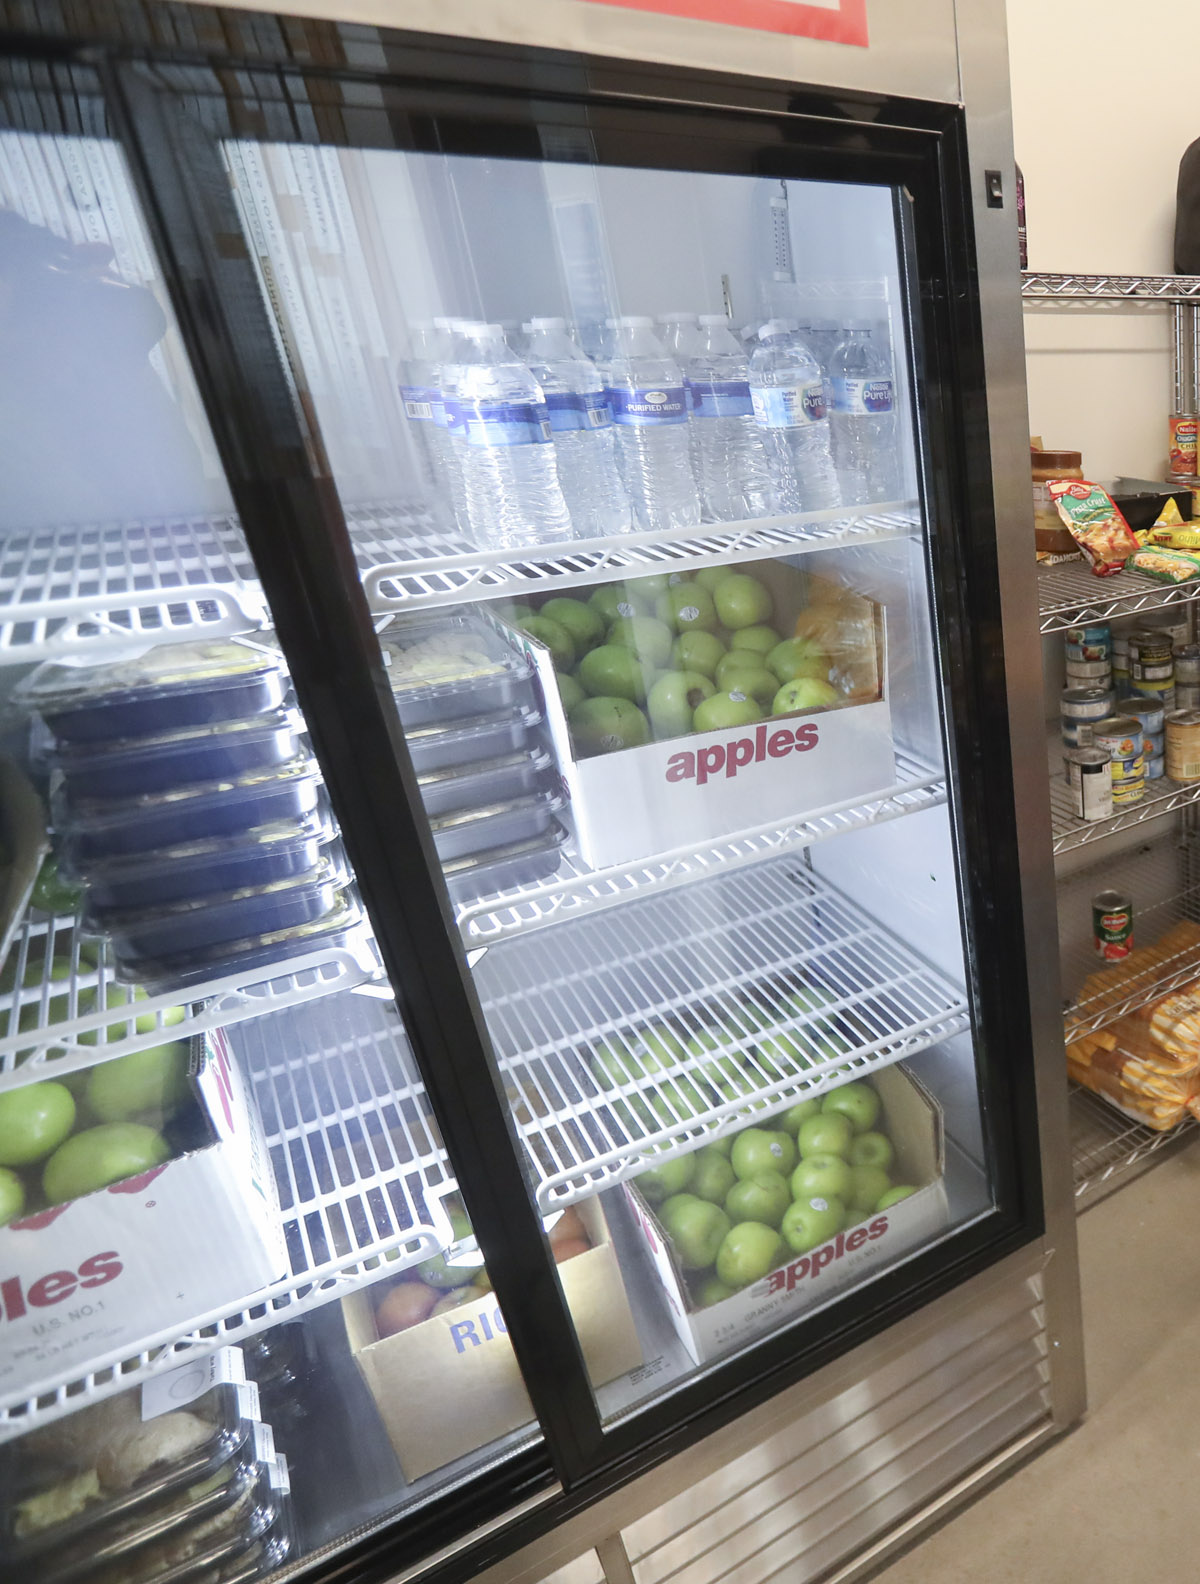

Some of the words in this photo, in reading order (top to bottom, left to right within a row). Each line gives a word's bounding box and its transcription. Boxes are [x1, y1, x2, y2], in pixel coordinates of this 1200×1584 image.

[864, 391, 883, 400] Pure
[627, 404, 662, 412] PURIFIED
[662, 403, 681, 411] WATER
[1087, 497, 1106, 507] Crust
[665, 723, 819, 785] apples
[752, 1216, 889, 1298] apples
[0, 1249, 124, 1322] les
[32, 1317, 65, 1337] U.S.
